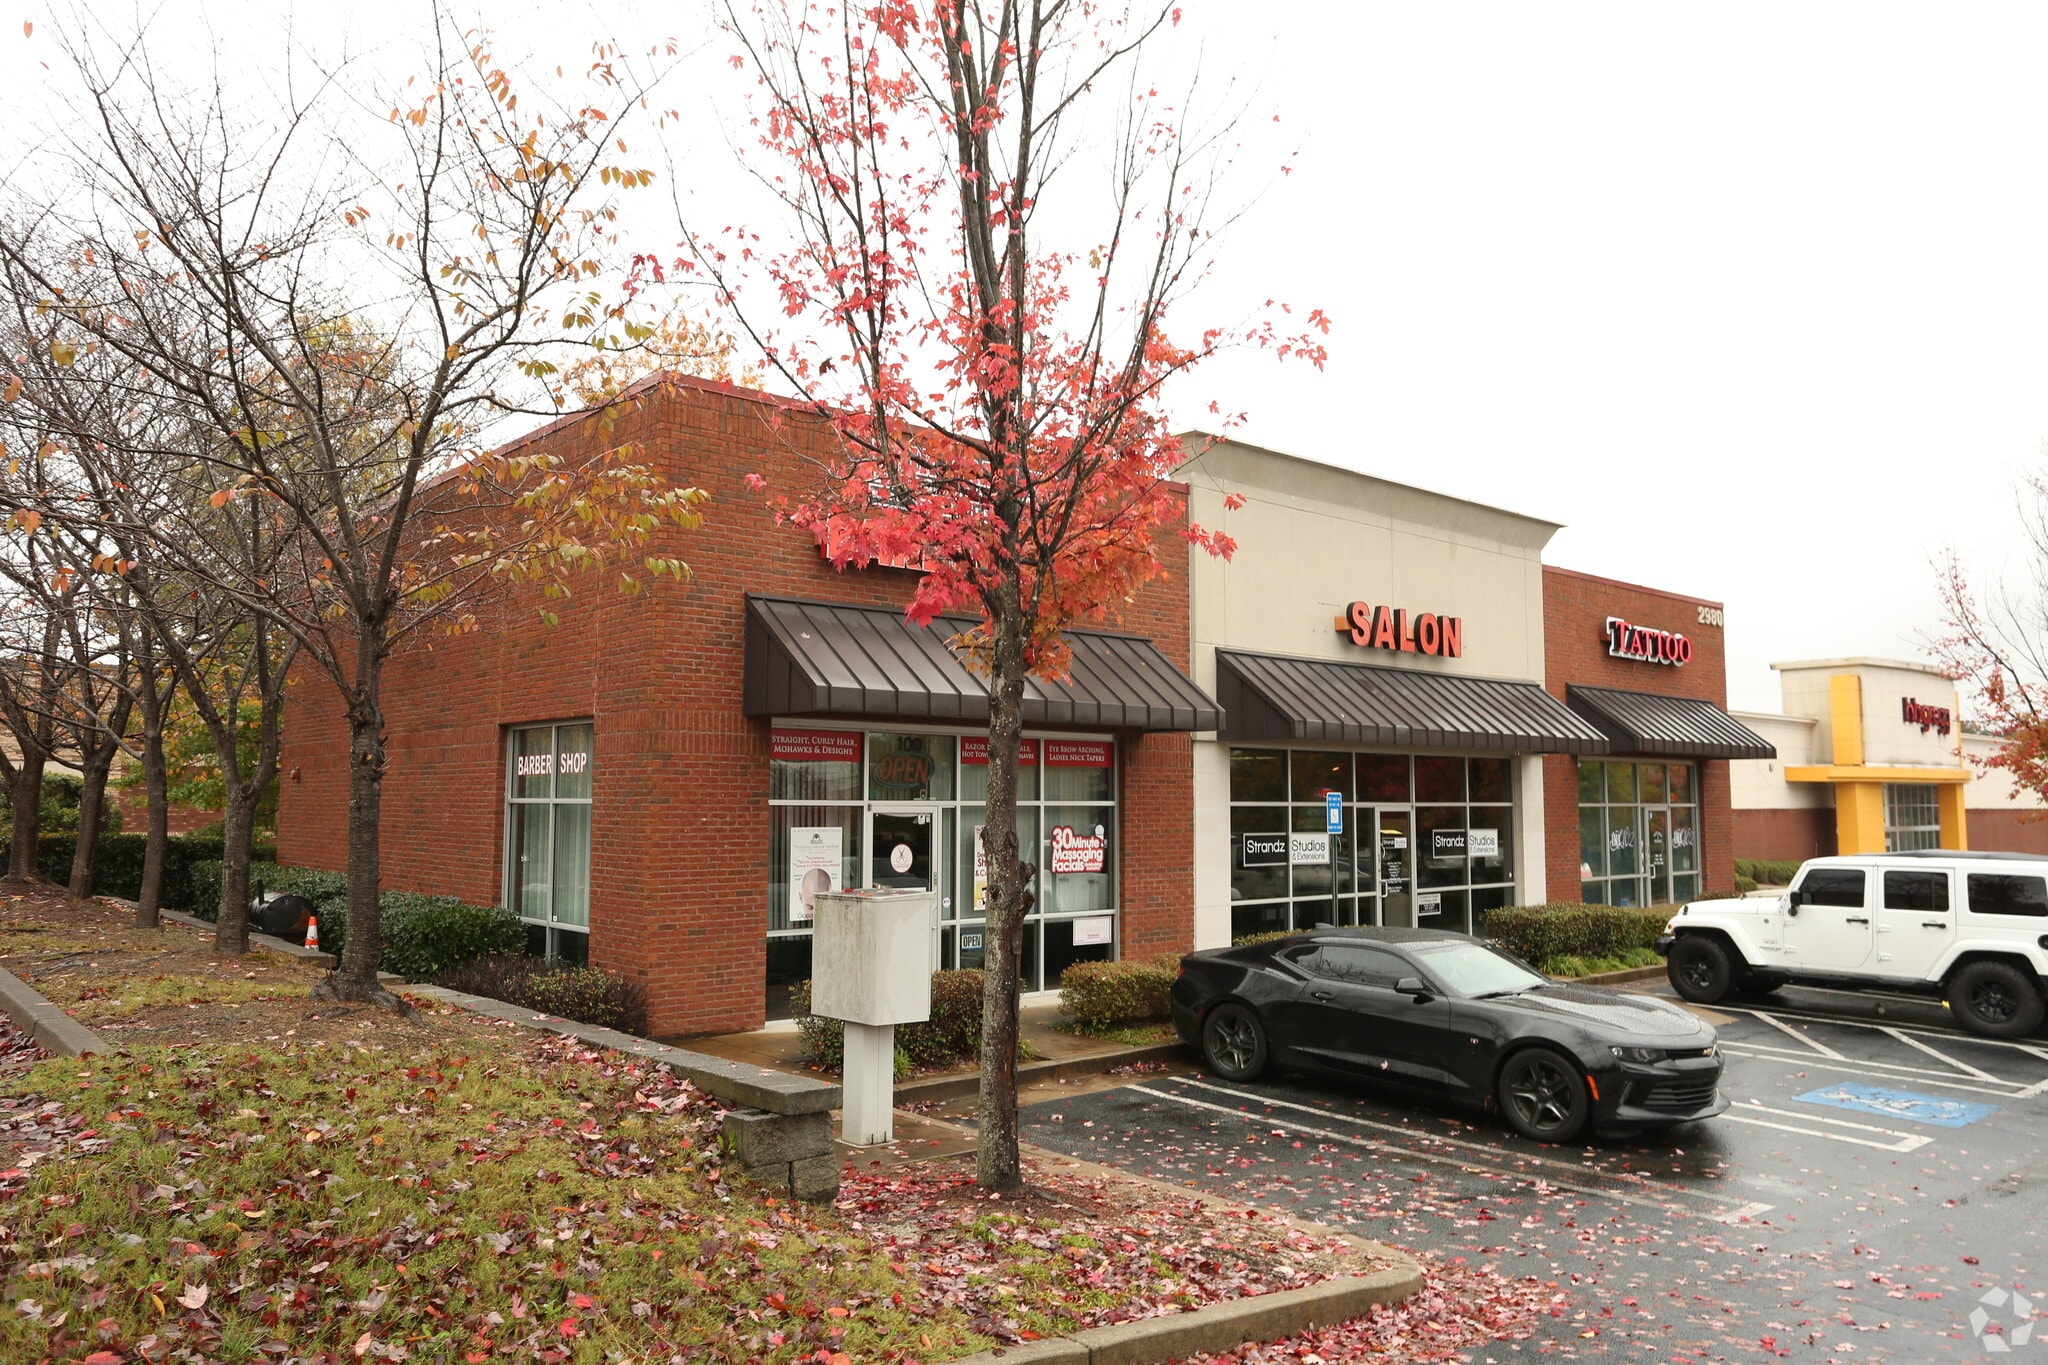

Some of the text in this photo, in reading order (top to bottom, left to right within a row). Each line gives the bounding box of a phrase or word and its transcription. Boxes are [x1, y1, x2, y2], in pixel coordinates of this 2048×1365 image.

[1697, 606, 1723, 626] 2980
[1346, 601, 1461, 658] SALON
[1609, 617, 1692, 664] TATTOO
[771, 735, 858, 747] STRAIGHT, CURLY HAIR,
[965, 743, 986, 751] RAZOR
[774, 744, 813, 754] MOHAWKS
[822, 746, 853, 755] DESIGNS
[1049, 745, 1059, 753] EYE
[1061, 745, 1077, 753] BROW
[518, 753, 587, 776] BARBER SHOP
[1049, 753, 1068, 761] LADIES
[1086, 754, 1105, 762] TAPERS
[878, 755, 929, 783] OPEN
[1052, 827, 1100, 849] 30 Minute
[1435, 834, 1496, 848] Strandz Studios
[1247, 839, 1326, 854] Strandz Studios
[1053, 847, 1104, 863] Massaging
[1297, 852, 1326, 860] Extensions
[1052, 859, 1085, 873] Facials
[963, 935, 981, 948] OPEN
